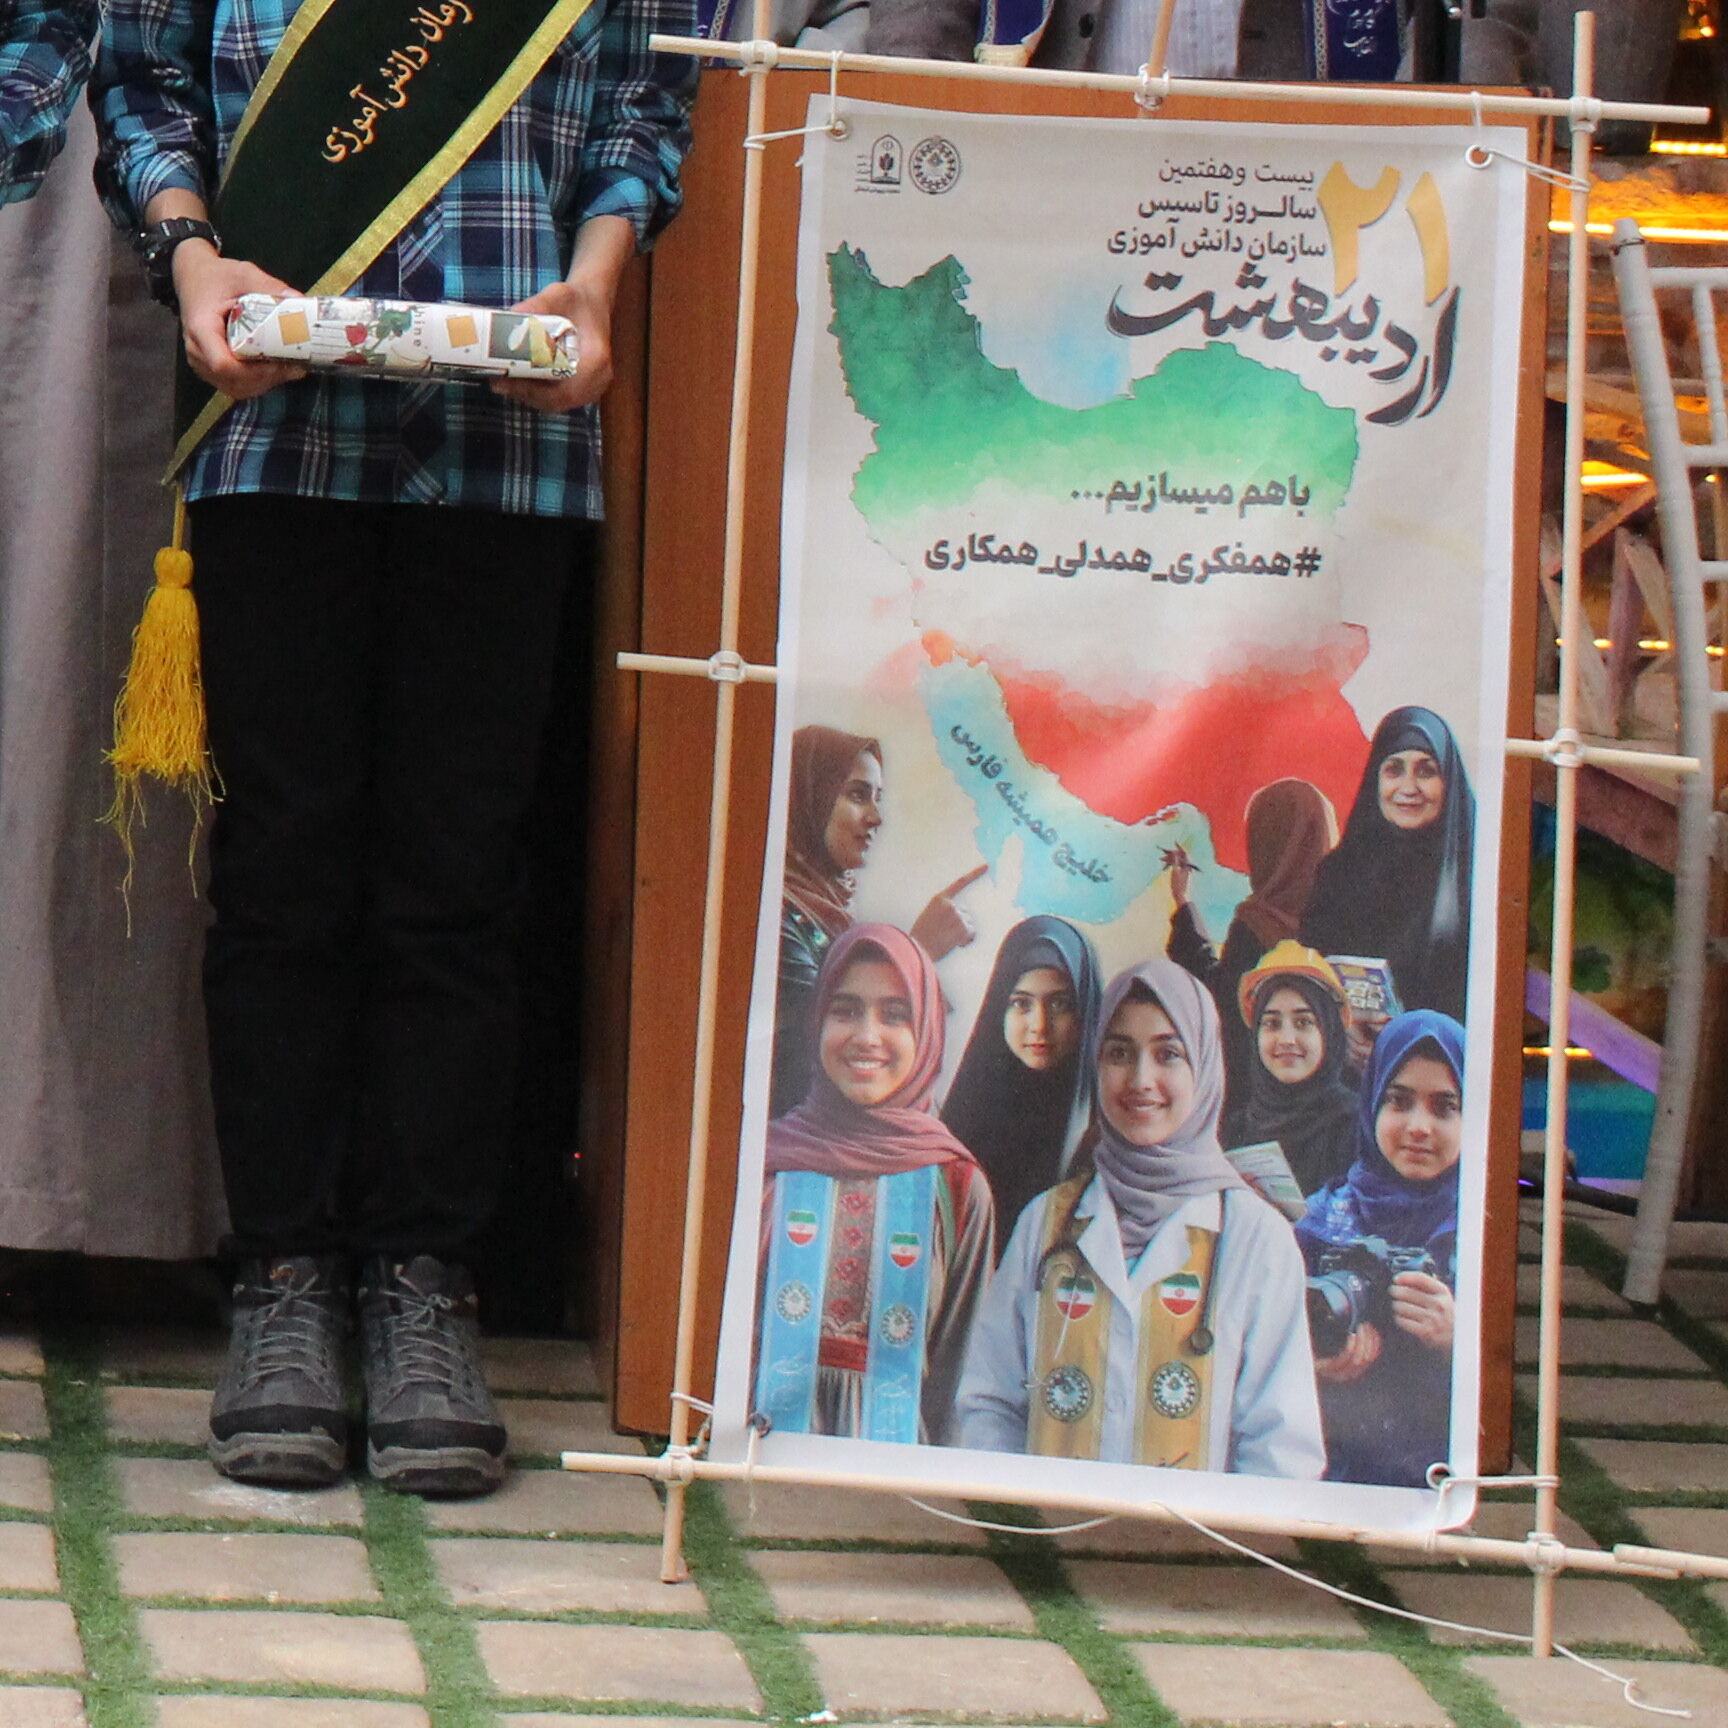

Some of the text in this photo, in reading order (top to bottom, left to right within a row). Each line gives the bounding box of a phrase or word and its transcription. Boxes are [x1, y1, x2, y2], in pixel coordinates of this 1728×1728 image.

[380, 45, 431, 110] دانش
[322, 83, 389, 164] آموزی
[1138, 189, 1219, 220] تاسیس
[1254, 162, 1315, 192] بیست
[1107, 217, 1327, 262] سازمان دانش آموزی
[1316, 160, 1450, 307] ۲۱
[1106, 261, 1461, 426] اردیبهشت
[950, 724, 1113, 884] خلیج همیشه فارس
